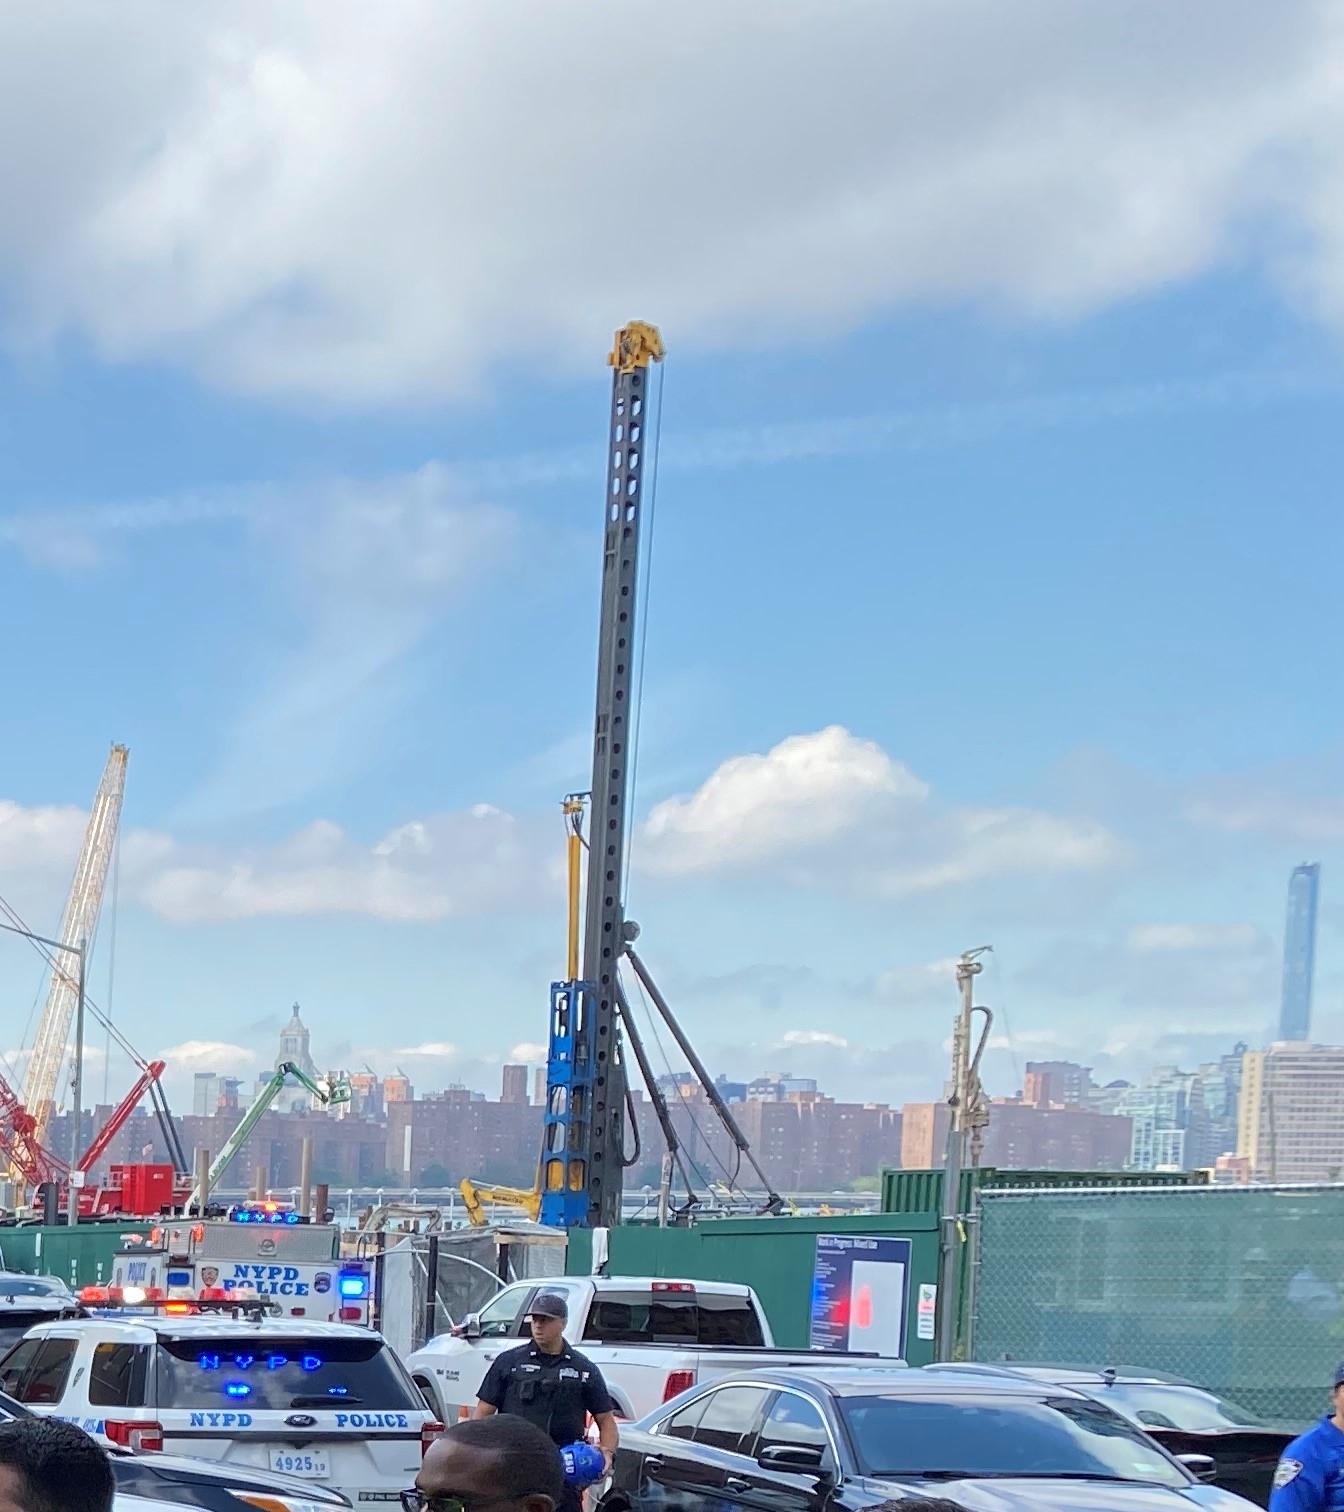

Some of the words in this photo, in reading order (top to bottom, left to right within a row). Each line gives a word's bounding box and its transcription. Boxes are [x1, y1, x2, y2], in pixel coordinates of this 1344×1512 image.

[234, 1264, 299, 1280] NYPD
[199, 1354, 323, 1371] NYPD
[190, 1413, 253, 1427] NYPD
[335, 1414, 408, 1428] POLICE
[275, 1455, 313, 1472] 4925
[314, 1462, 326, 1471] 19
[564, 1453, 574, 1473] ESU
